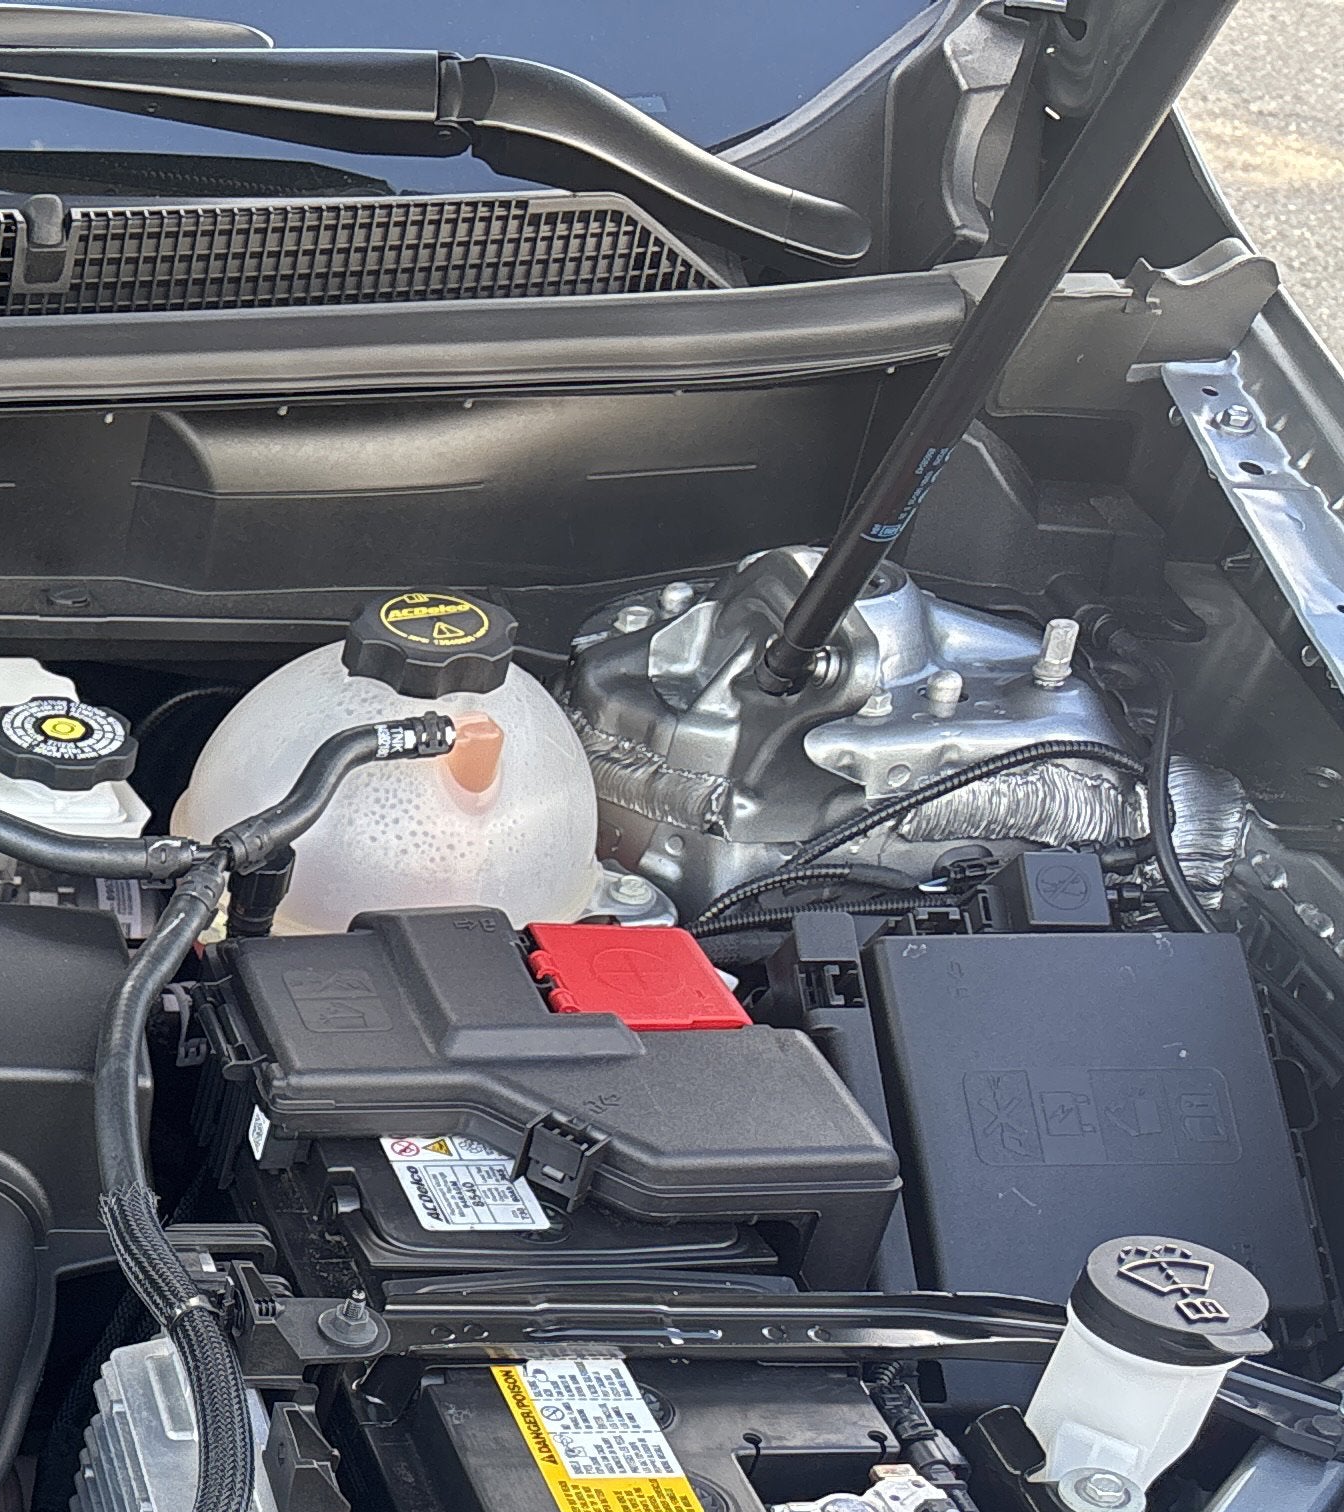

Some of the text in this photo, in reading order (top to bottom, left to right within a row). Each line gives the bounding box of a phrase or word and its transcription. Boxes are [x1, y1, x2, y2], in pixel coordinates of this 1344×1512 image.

[388, 604, 470, 620] ACDelco
[389, 726, 404, 753] TNK
[406, 1165, 444, 1223] ACDelco
[500, 1369, 552, 1454] DANGER/POISON
